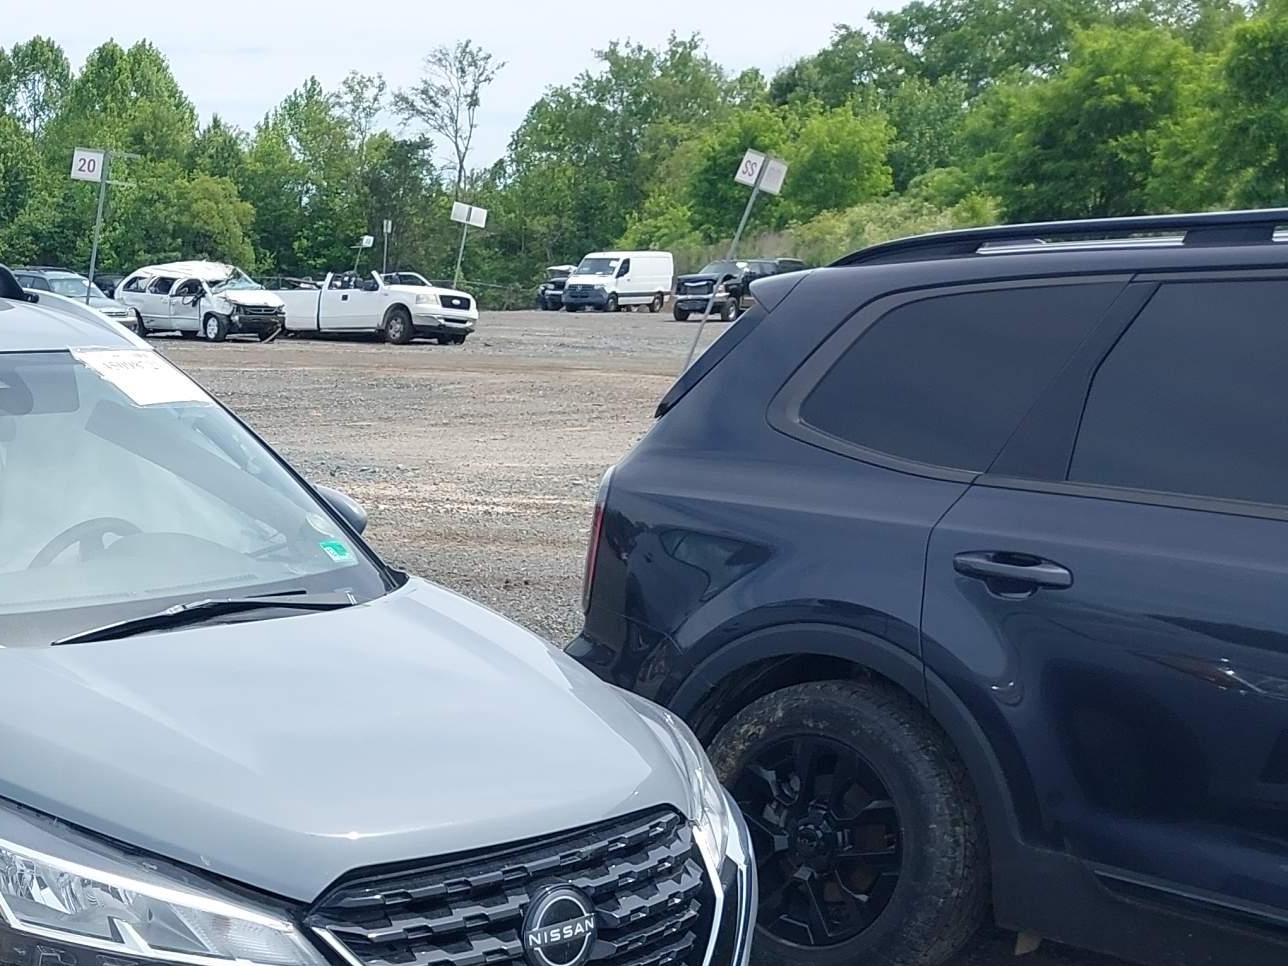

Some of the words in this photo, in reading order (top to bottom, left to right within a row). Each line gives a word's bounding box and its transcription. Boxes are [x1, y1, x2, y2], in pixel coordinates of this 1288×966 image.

[78, 157, 96, 173] 20
[742, 159, 757, 177] SS
[528, 916, 595, 947] NISSAN
